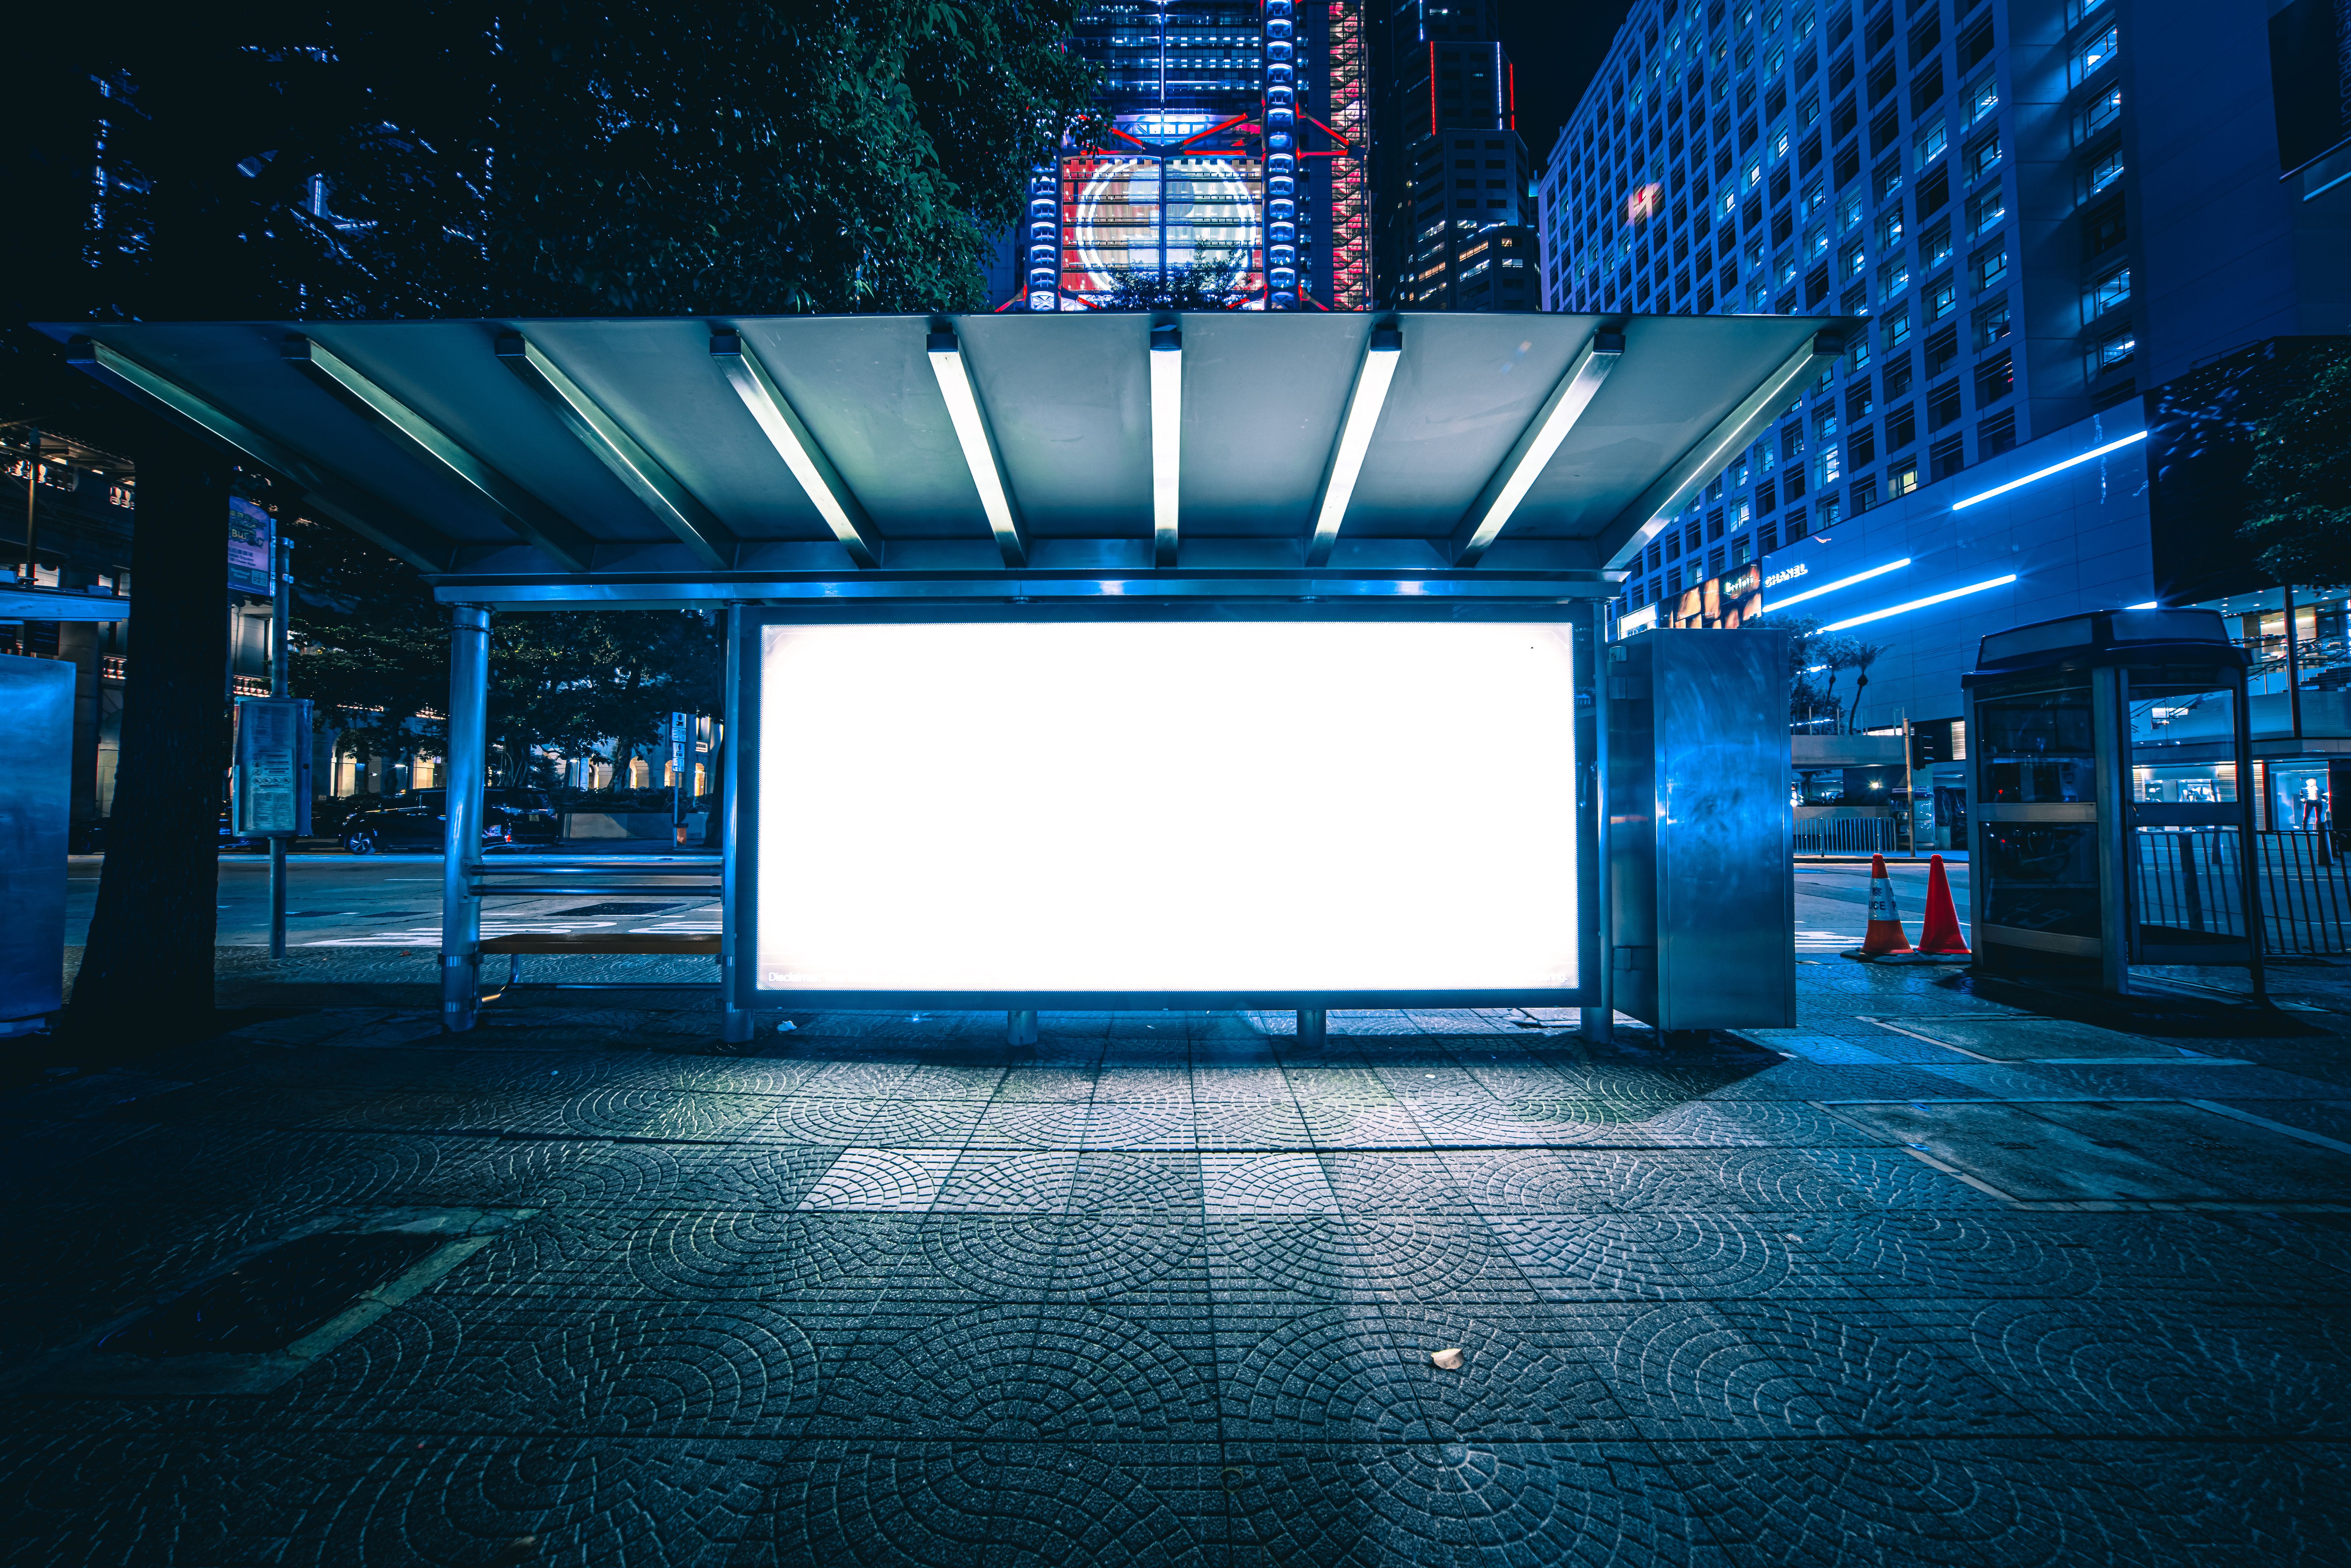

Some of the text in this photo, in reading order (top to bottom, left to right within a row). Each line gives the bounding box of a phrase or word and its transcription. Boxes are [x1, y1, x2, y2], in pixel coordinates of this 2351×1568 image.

[232, 529, 250, 540] BUS
[1764, 563, 1808, 588] CHANEL
[2013, 678, 2064, 690] Phonecard
